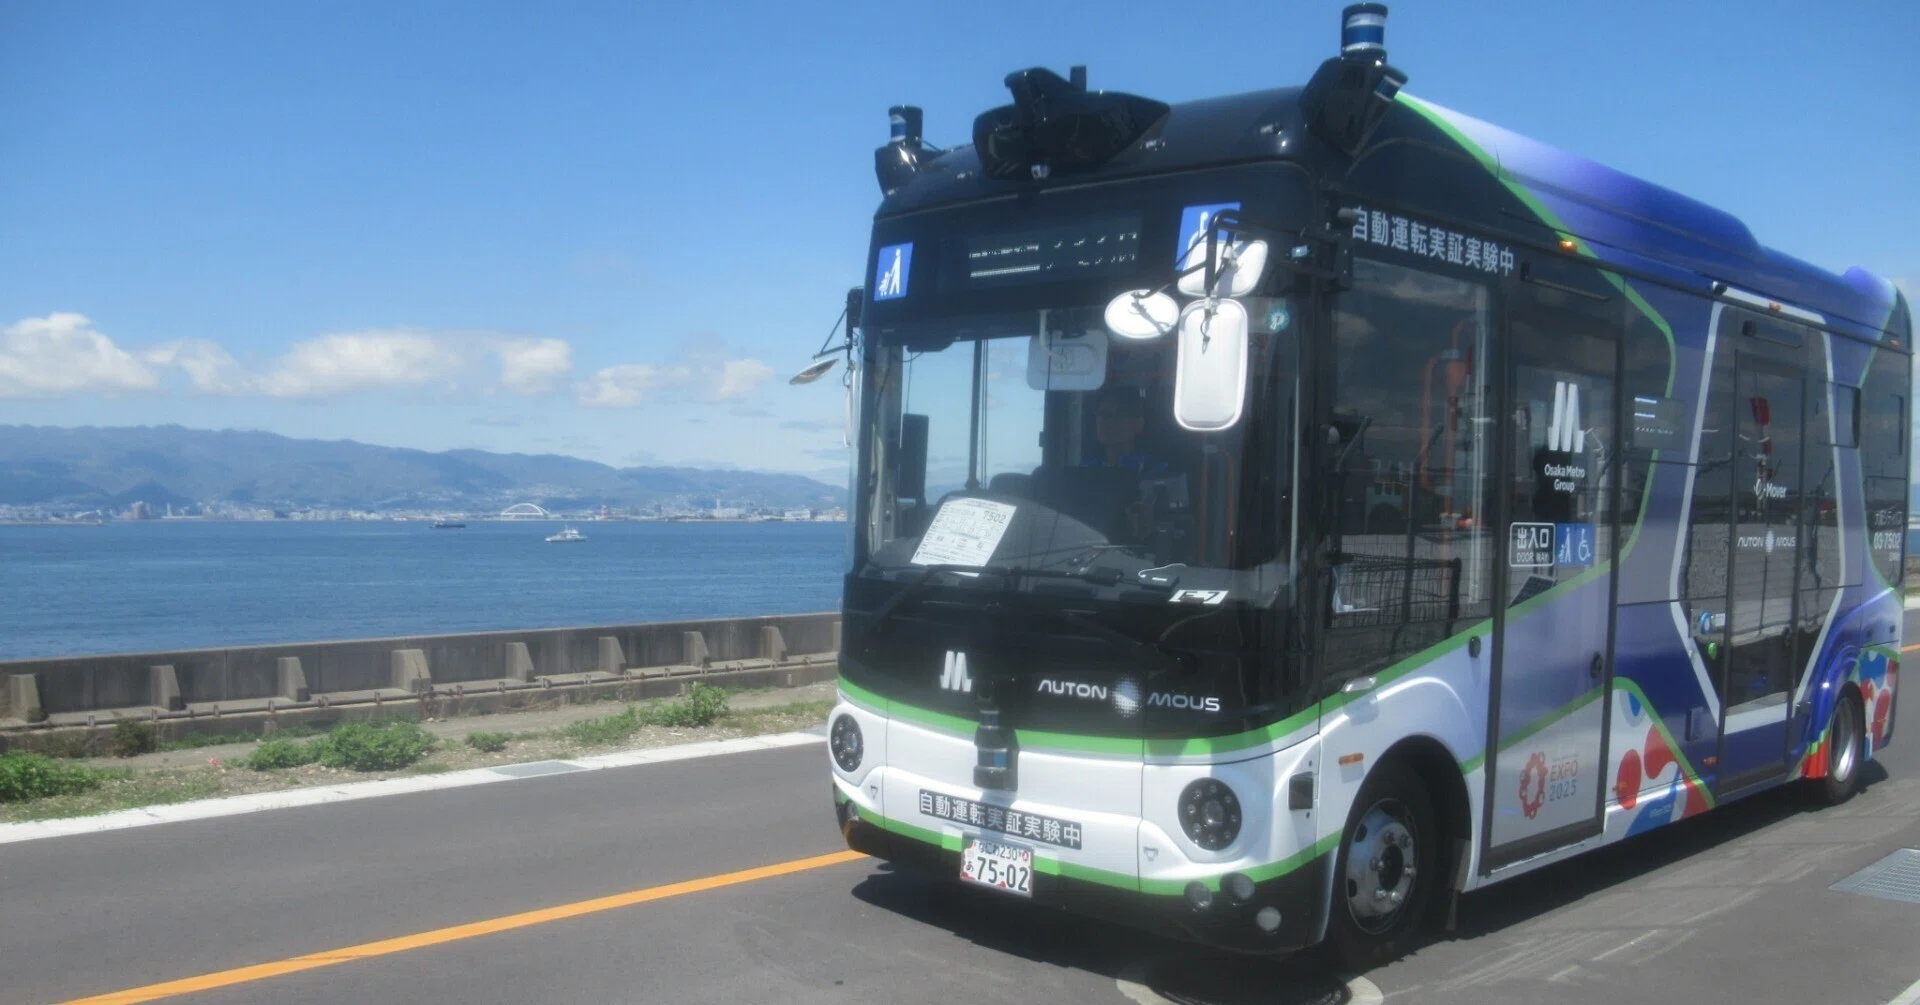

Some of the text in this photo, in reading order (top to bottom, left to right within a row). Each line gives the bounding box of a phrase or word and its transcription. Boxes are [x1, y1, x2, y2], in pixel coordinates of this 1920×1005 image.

[1352, 205, 1514, 277] 自動運転実証実験中
[1544, 463, 1585, 479] Osaka Metro
[1554, 479, 1575, 493] Group
[983, 510, 1007, 524] 7502
[1517, 527, 1549, 549] 出入口
[1517, 552, 1549, 563] DOOR WAY
[1550, 760, 1579, 783] EXPO
[1550, 779, 1578, 801] 2025
[920, 792, 1080, 847] 自動運転実証実験中
[1000, 845, 1018, 861] 230
[977, 856, 1030, 892] 75-02
